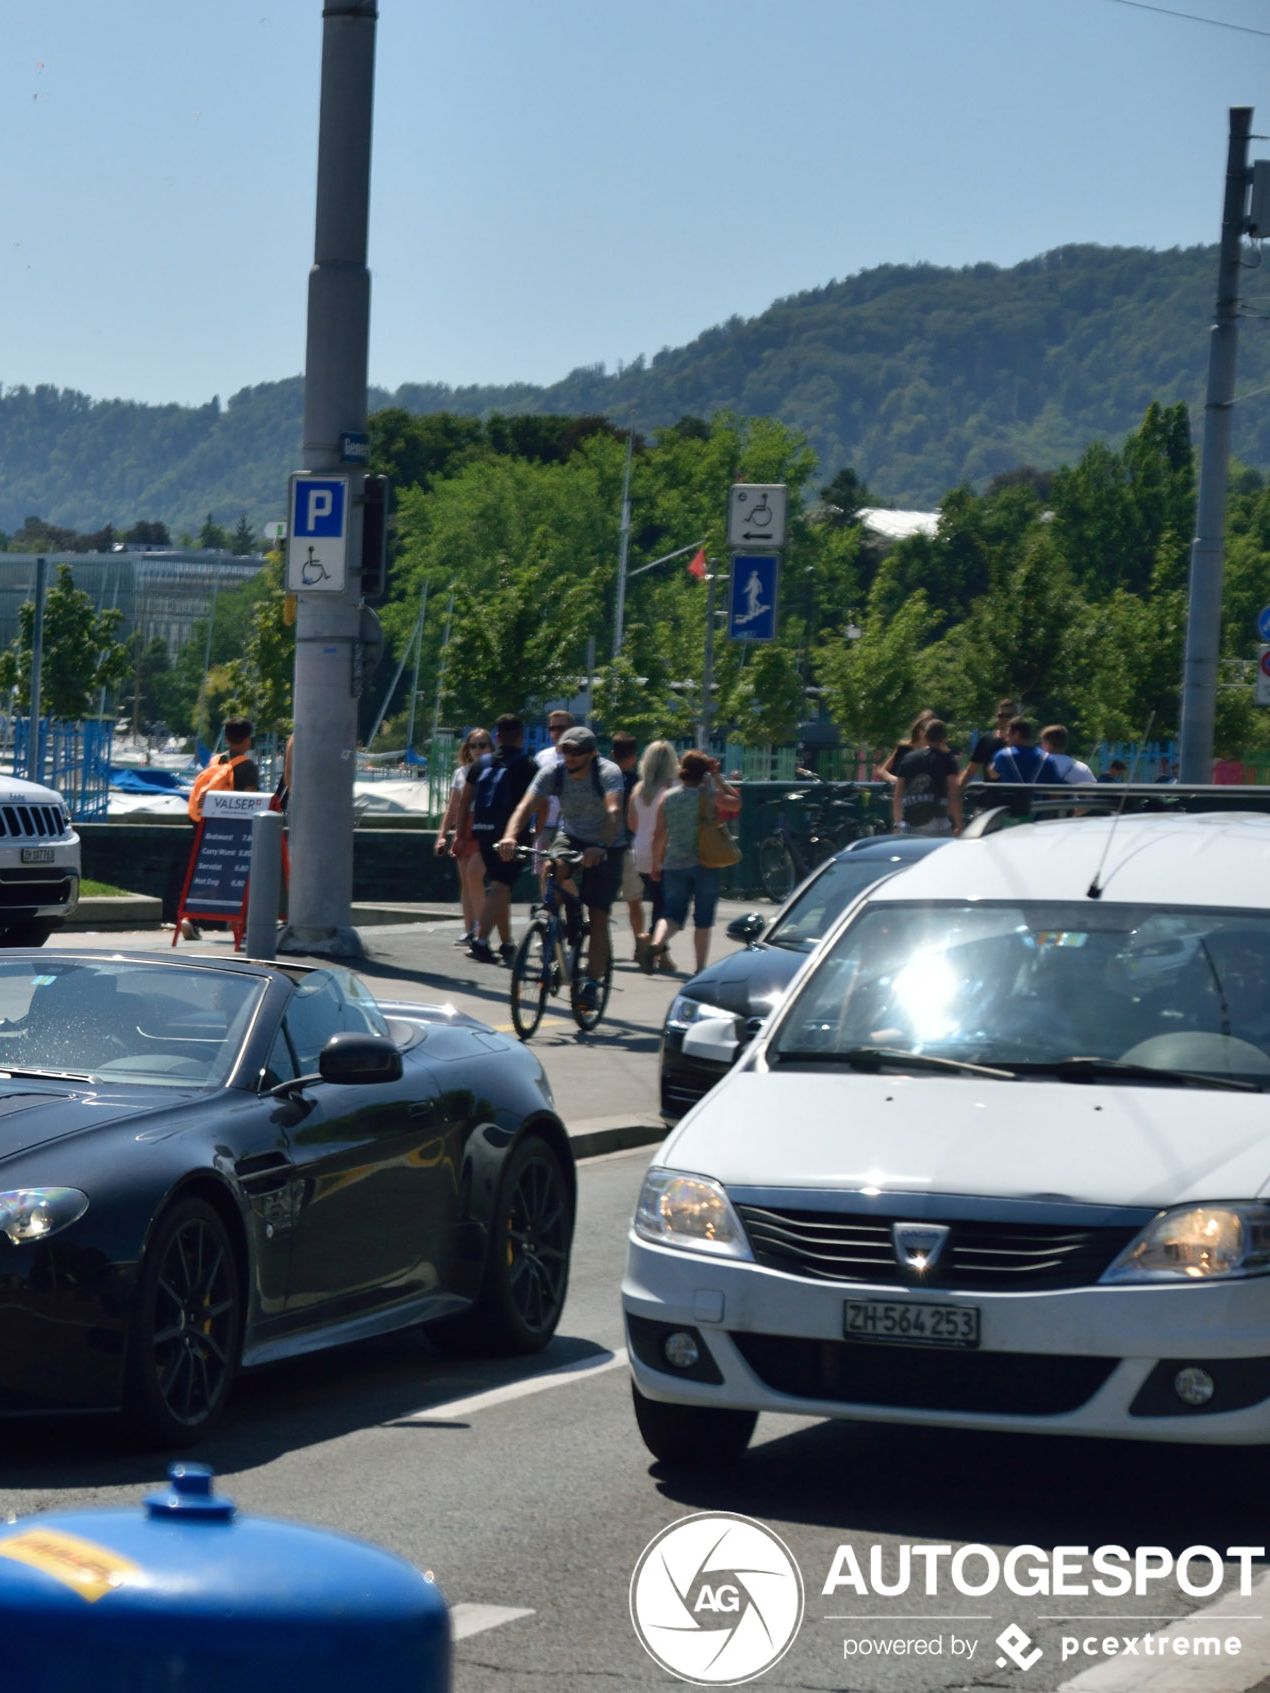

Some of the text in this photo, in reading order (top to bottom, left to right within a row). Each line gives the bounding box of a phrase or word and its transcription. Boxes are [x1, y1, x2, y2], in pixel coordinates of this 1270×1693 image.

[307, 489, 332, 531] P
[214, 797, 256, 810] VALSER
[202, 847, 218, 856] Curry
[219, 848, 236, 856] Wurst
[930, 1310, 974, 1338] 253
